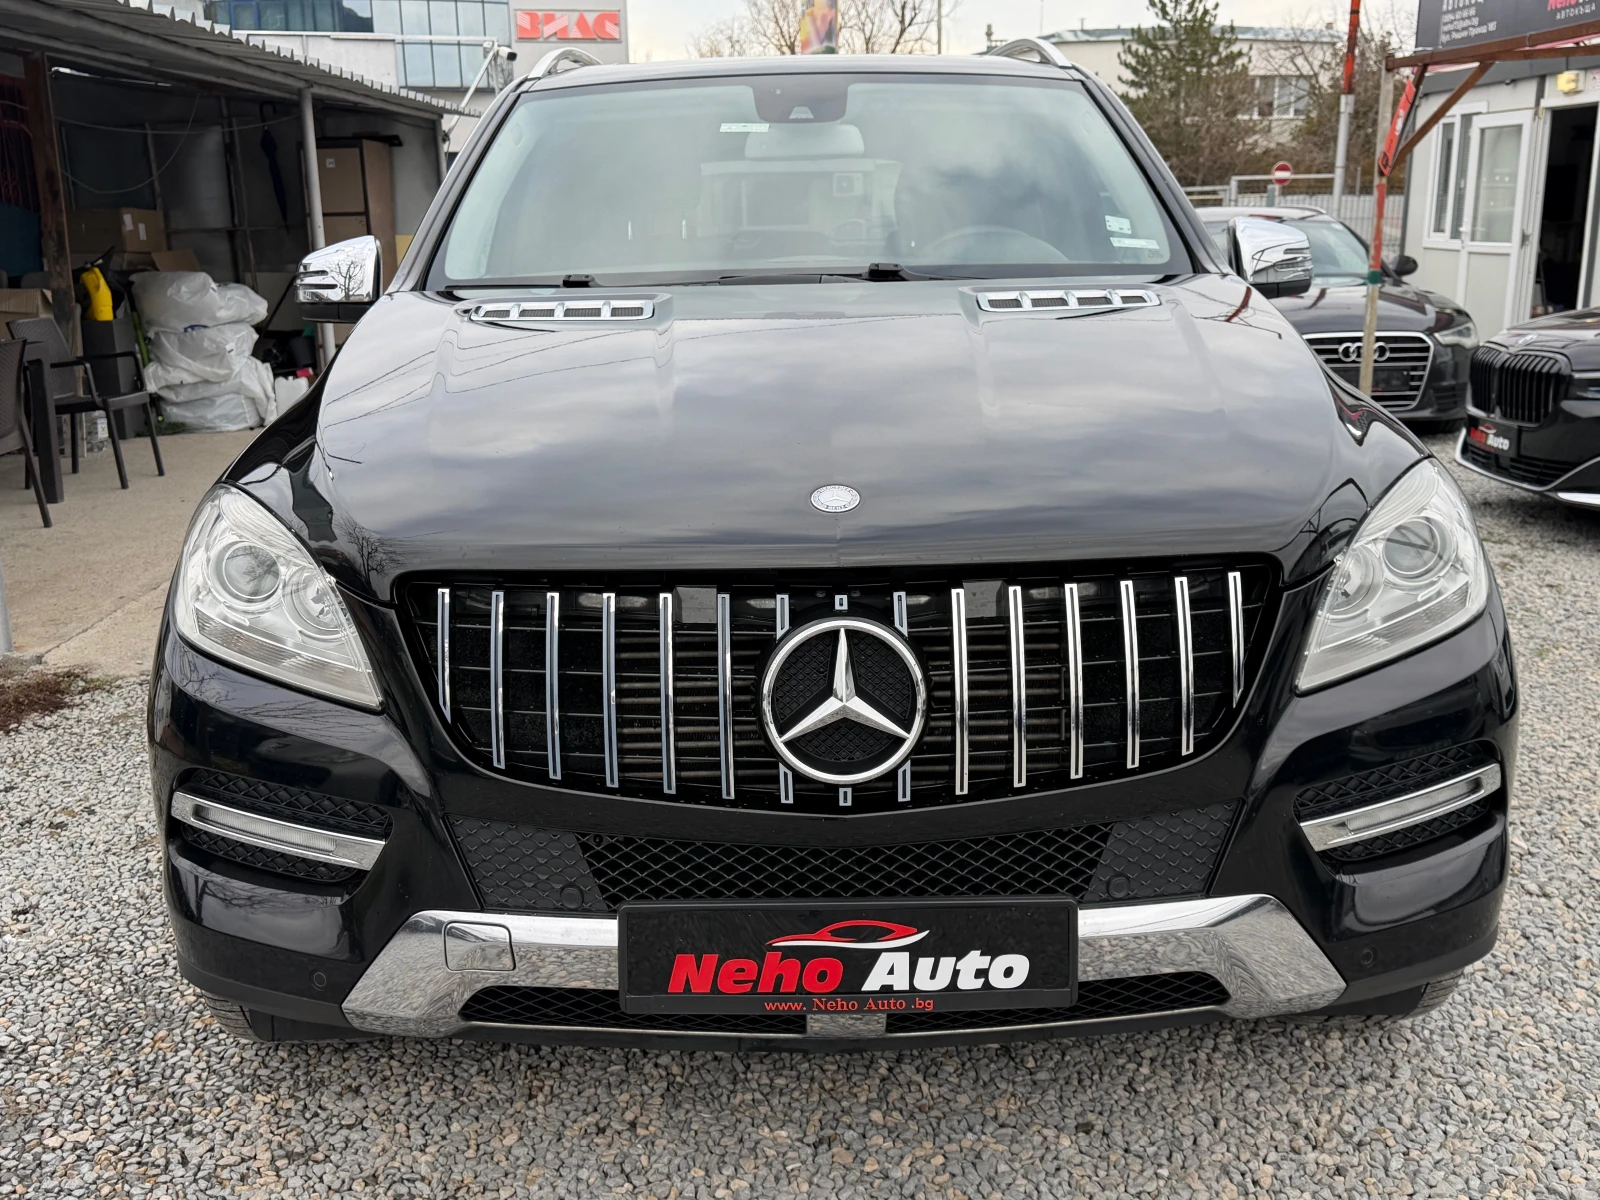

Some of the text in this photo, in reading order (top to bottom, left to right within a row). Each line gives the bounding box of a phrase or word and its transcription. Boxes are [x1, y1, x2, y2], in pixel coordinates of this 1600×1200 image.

[1556, 2, 1596, 20] АВТОКЪЩА
[1486, 434, 1510, 450] Auto
[667, 950, 1030, 994] Neho Auto
[764, 998, 934, 1011] www. Neho Auto .bg
